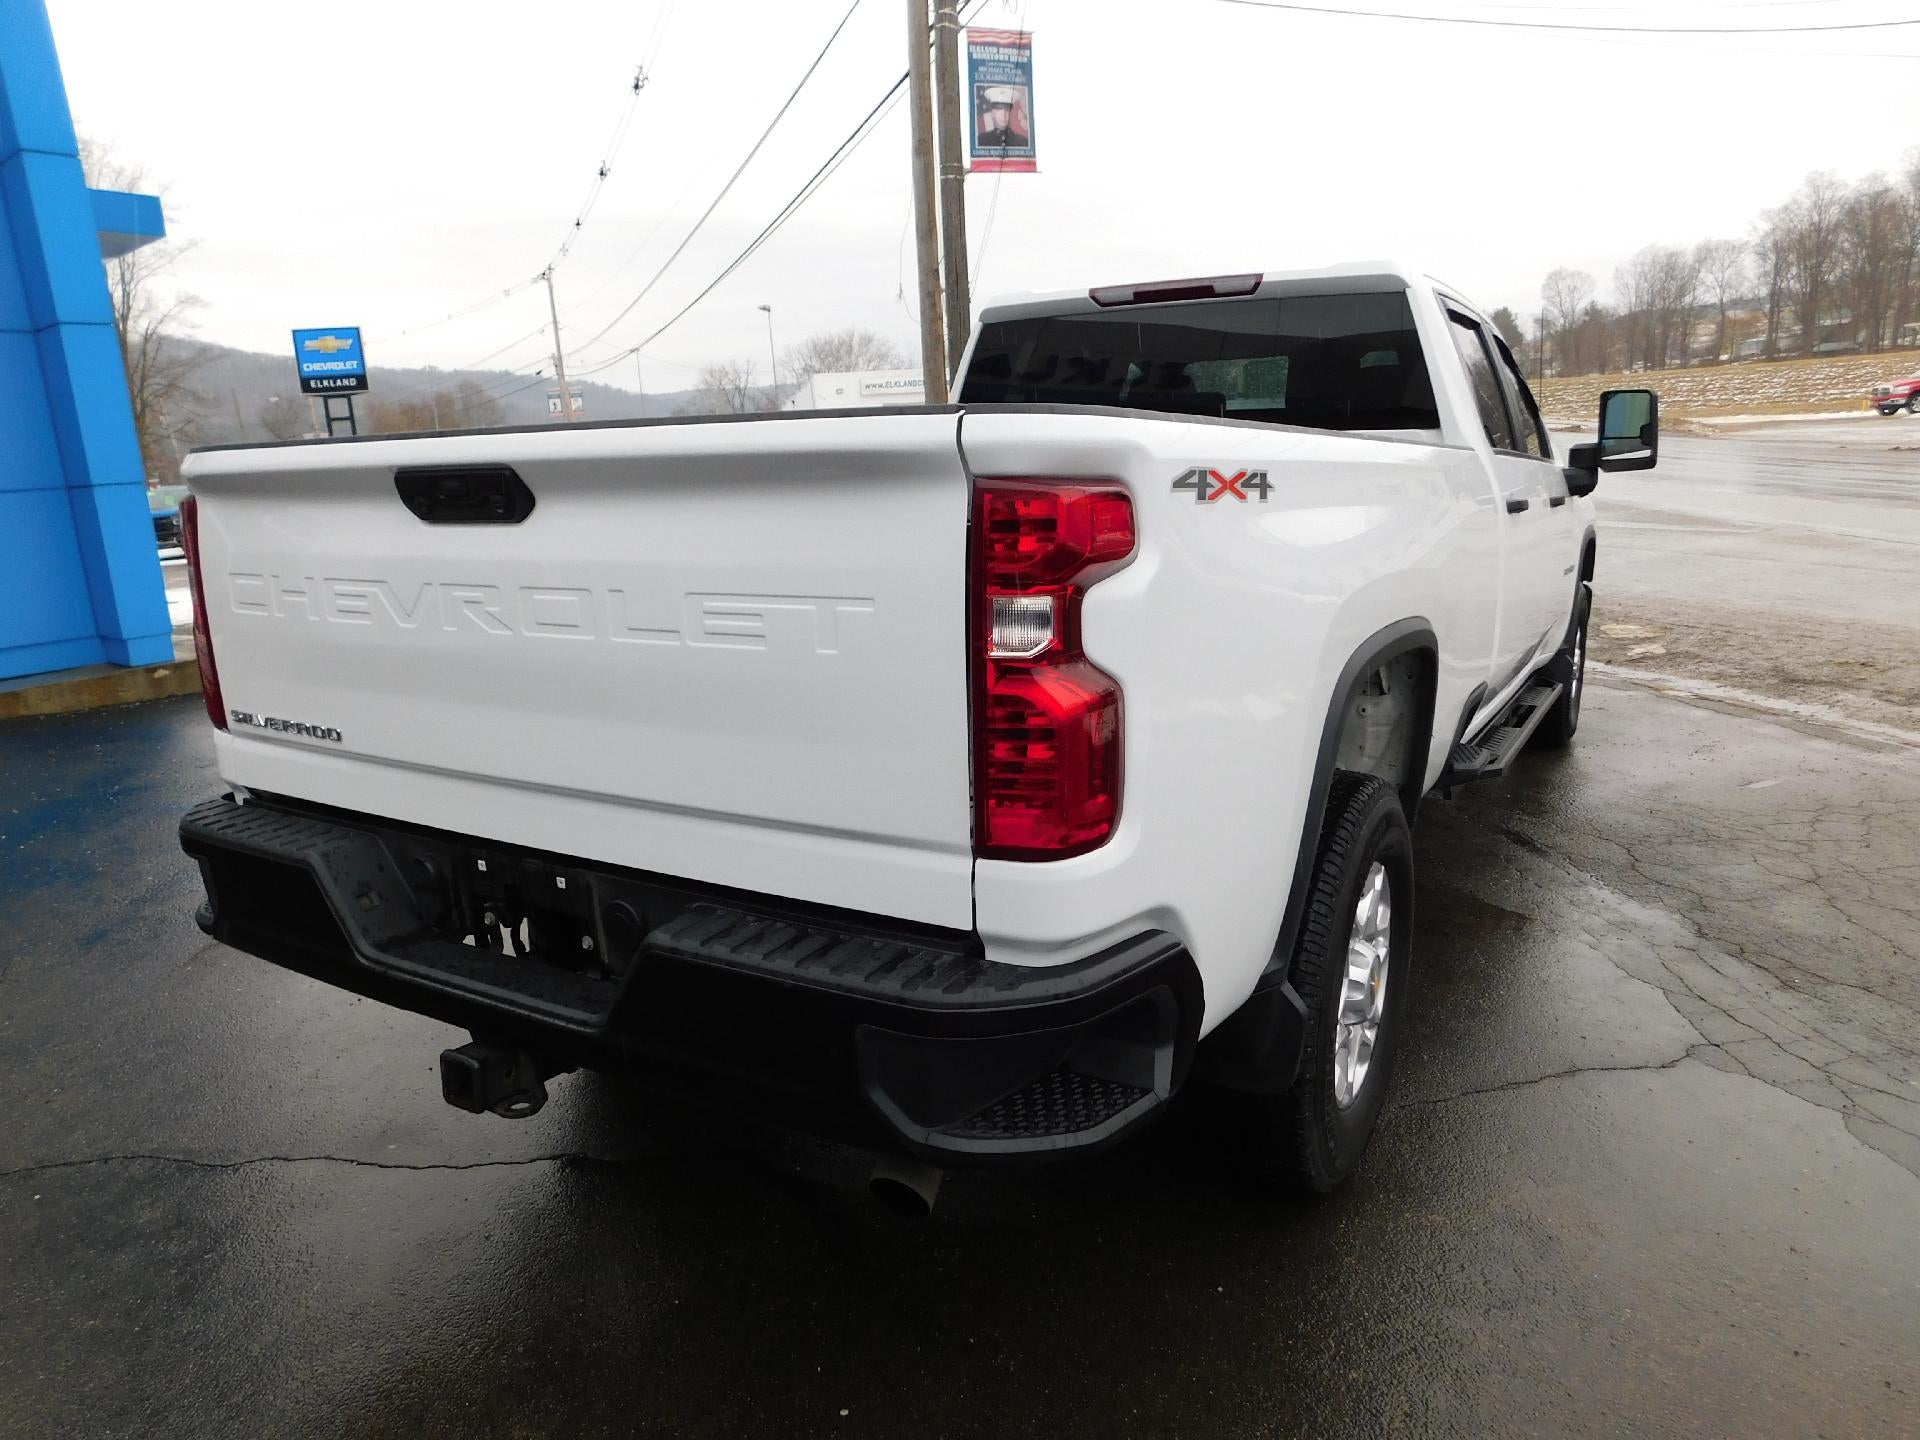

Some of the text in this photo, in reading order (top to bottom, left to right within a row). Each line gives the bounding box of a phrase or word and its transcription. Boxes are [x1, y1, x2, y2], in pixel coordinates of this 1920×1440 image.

[969, 44, 998, 54] ELKLAND
[972, 52, 1028, 63] HOMETOWN HERO
[303, 360, 358, 371] CHEVROLET
[310, 378, 357, 388] ELKLAND
[864, 379, 924, 391] WWW.ELKLANDC
[228, 572, 875, 654] CHEVROLET
[231, 709, 343, 742] SILVERADO
